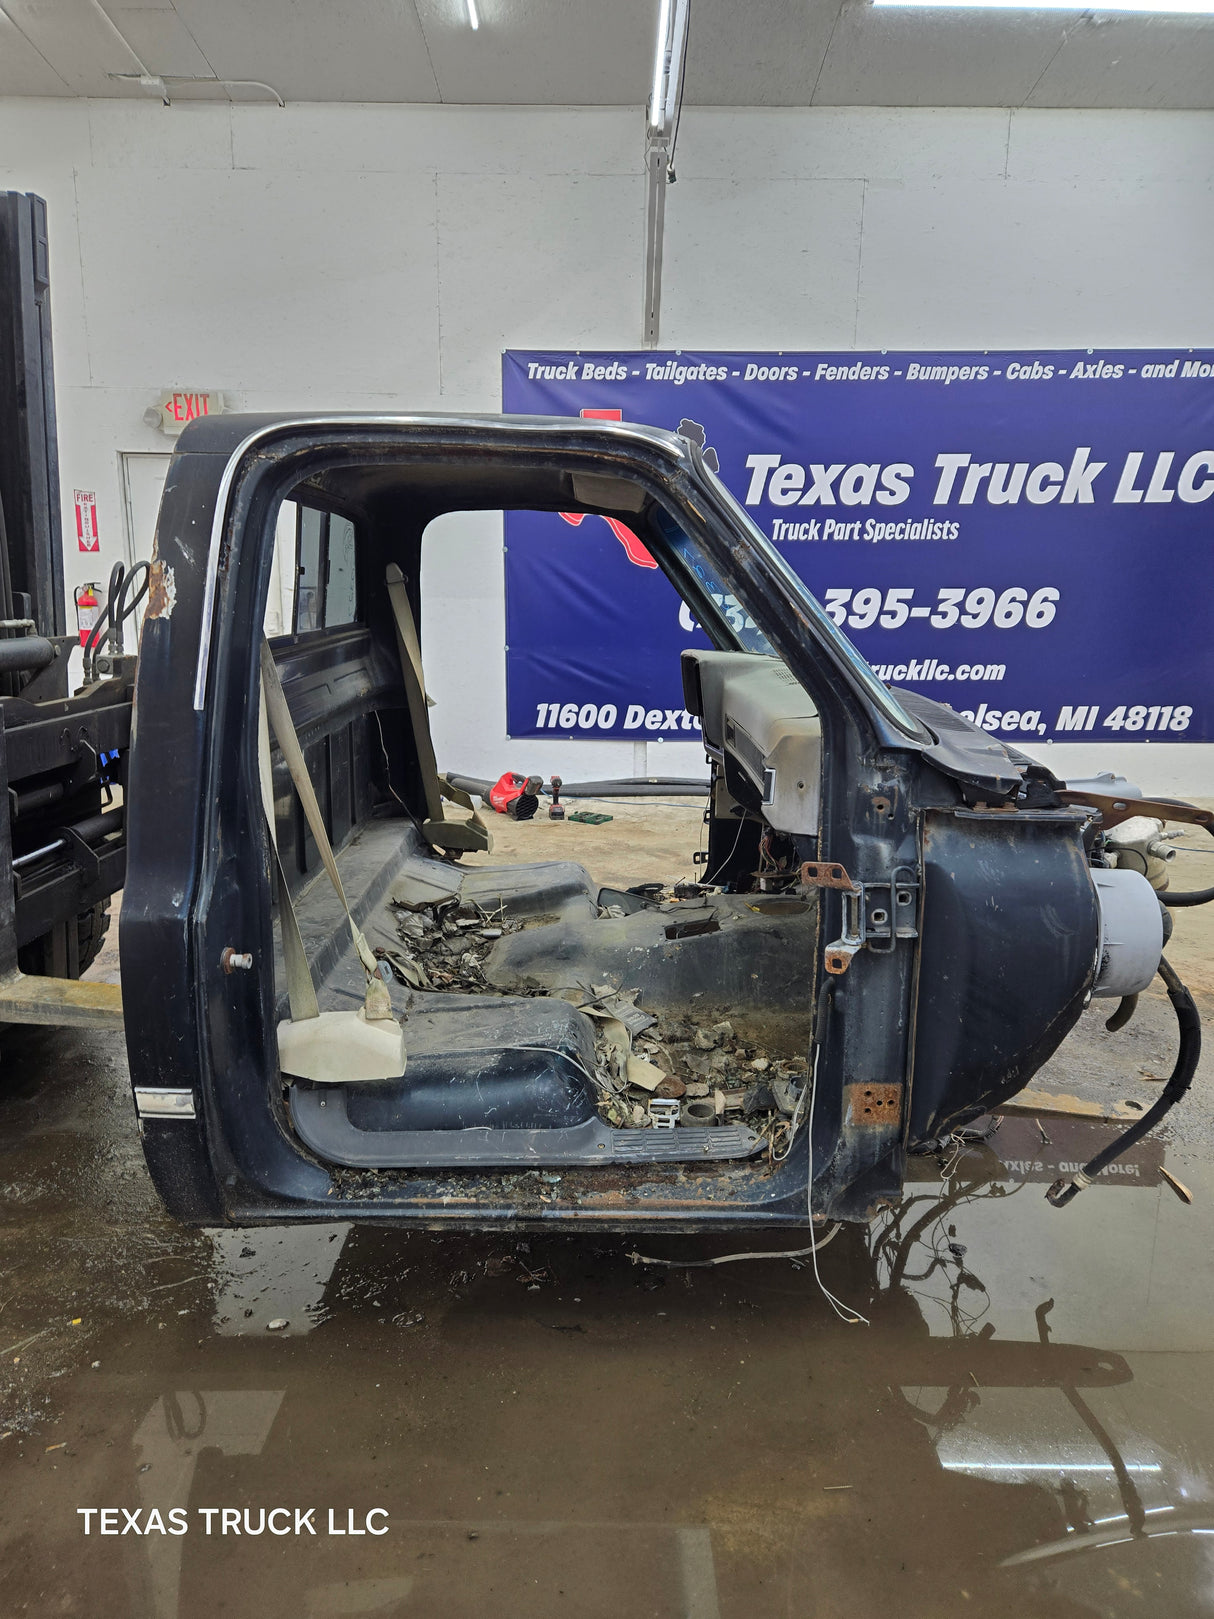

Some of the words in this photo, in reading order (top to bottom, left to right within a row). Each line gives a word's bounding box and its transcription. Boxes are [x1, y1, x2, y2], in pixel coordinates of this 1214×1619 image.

[528, 362, 578, 380] Truck
[581, 362, 628, 380] Beds
[645, 361, 728, 385] Tailgates
[744, 363, 798, 381] Doors
[814, 362, 890, 381] Fenders
[906, 362, 989, 385] Bumpers
[1006, 361, 1054, 380] Cabs
[1070, 360, 1124, 379] Axles
[1141, 360, 1177, 378] and
[173, 393, 209, 421] EXIT
[745, 454, 914, 506] Texas
[933, 447, 1107, 505] Truck
[1113, 449, 1214, 504] LLC
[76, 493, 94, 503] FIRE
[772, 518, 820, 541] Truck
[823, 519, 861, 541] Part
[863, 518, 960, 543] Specialists
[824, 586, 1060, 630] 395-3966
[866, 659, 1007, 682] ruckllc.com
[535, 703, 618, 729] 11600
[1055, 705, 1098, 731] MI
[1103, 705, 1193, 731] 48118
